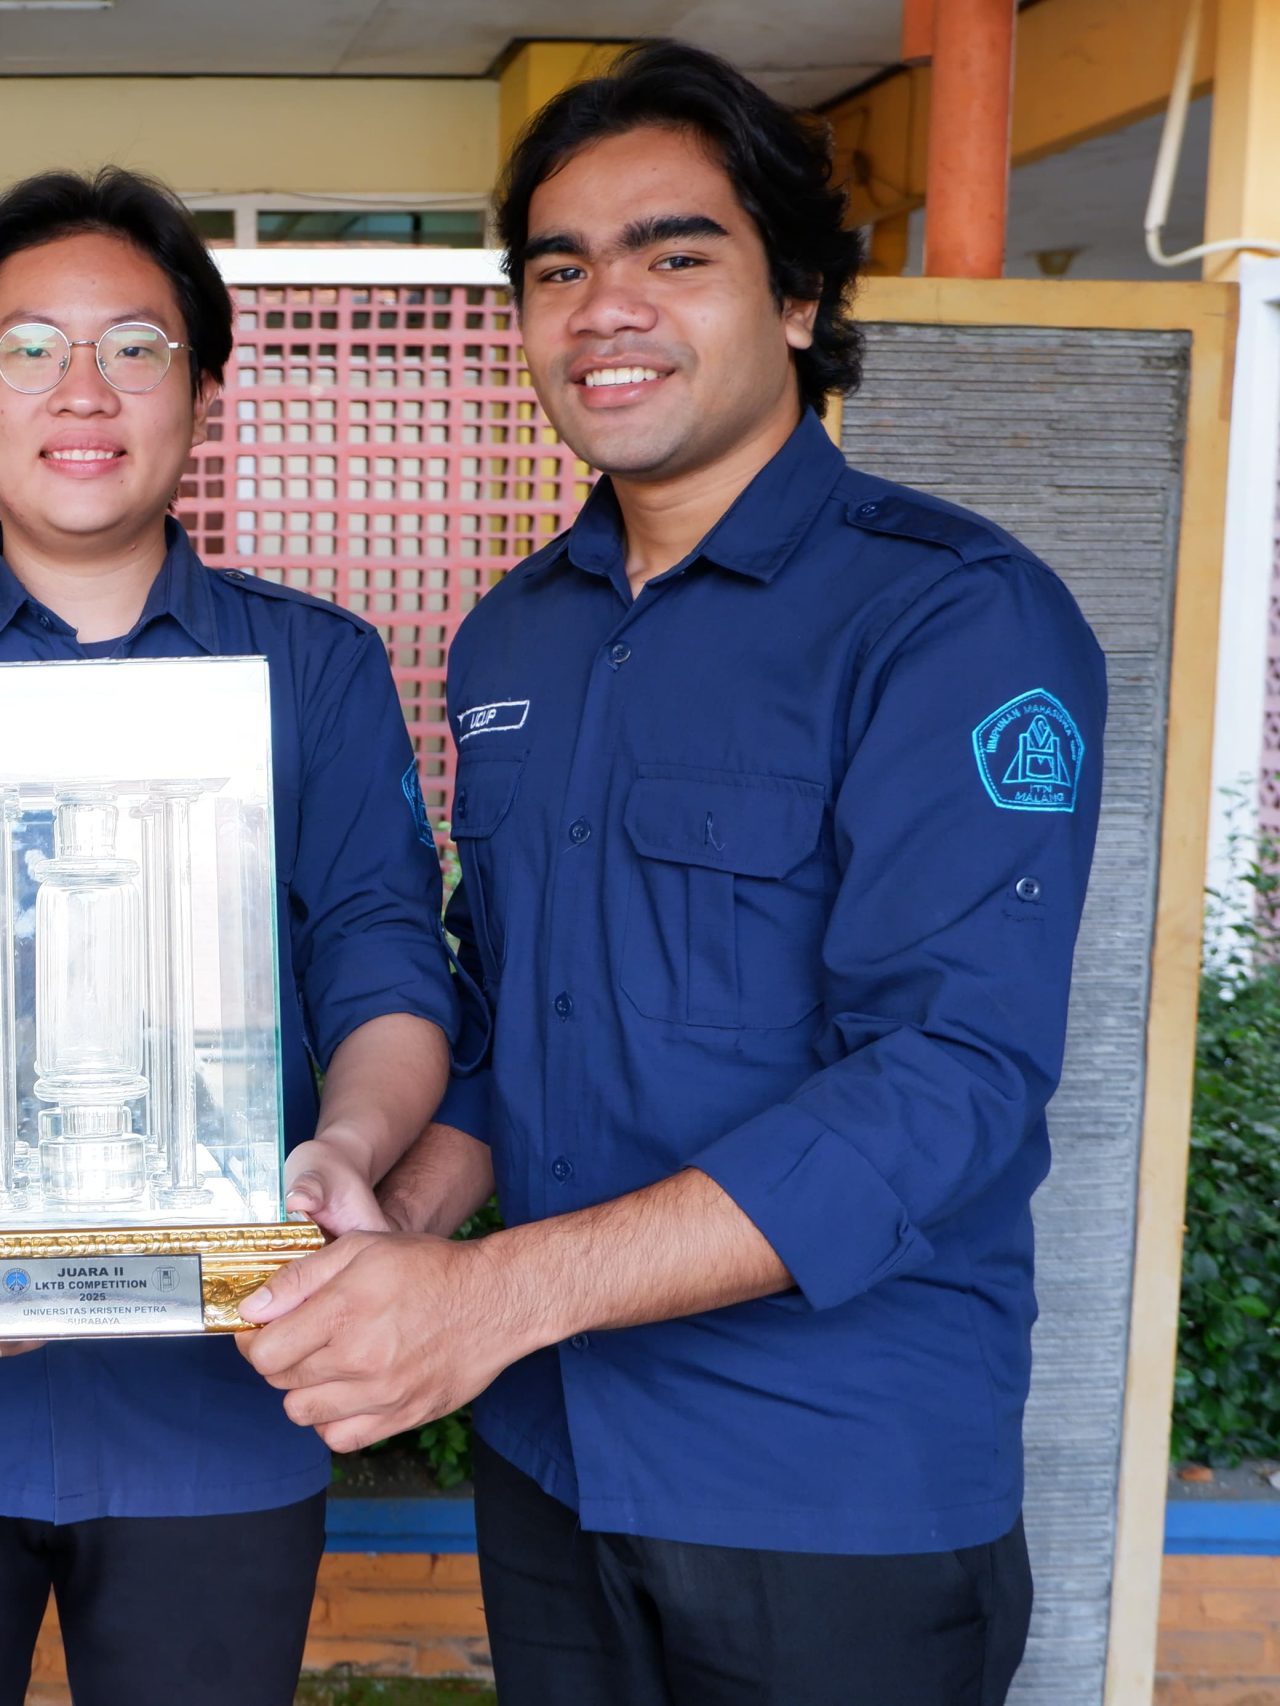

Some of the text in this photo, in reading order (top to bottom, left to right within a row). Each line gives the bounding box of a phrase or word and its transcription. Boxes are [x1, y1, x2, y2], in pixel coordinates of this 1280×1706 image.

[470, 708, 497, 729] UCUP
[986, 708, 1021, 753] HIMPUNAN
[1030, 784, 1053, 793] ITN
[1015, 791, 1065, 802] MALANG
[57, 1266, 124, 1278] JUARA II
[35, 1279, 147, 1291] LKTB COMPETITION
[79, 1292, 106, 1302] 2025
[23, 1305, 167, 1316] UNIVERSITAS KRISTEN PETRA
[67, 1317, 120, 1325] SURABAYA
